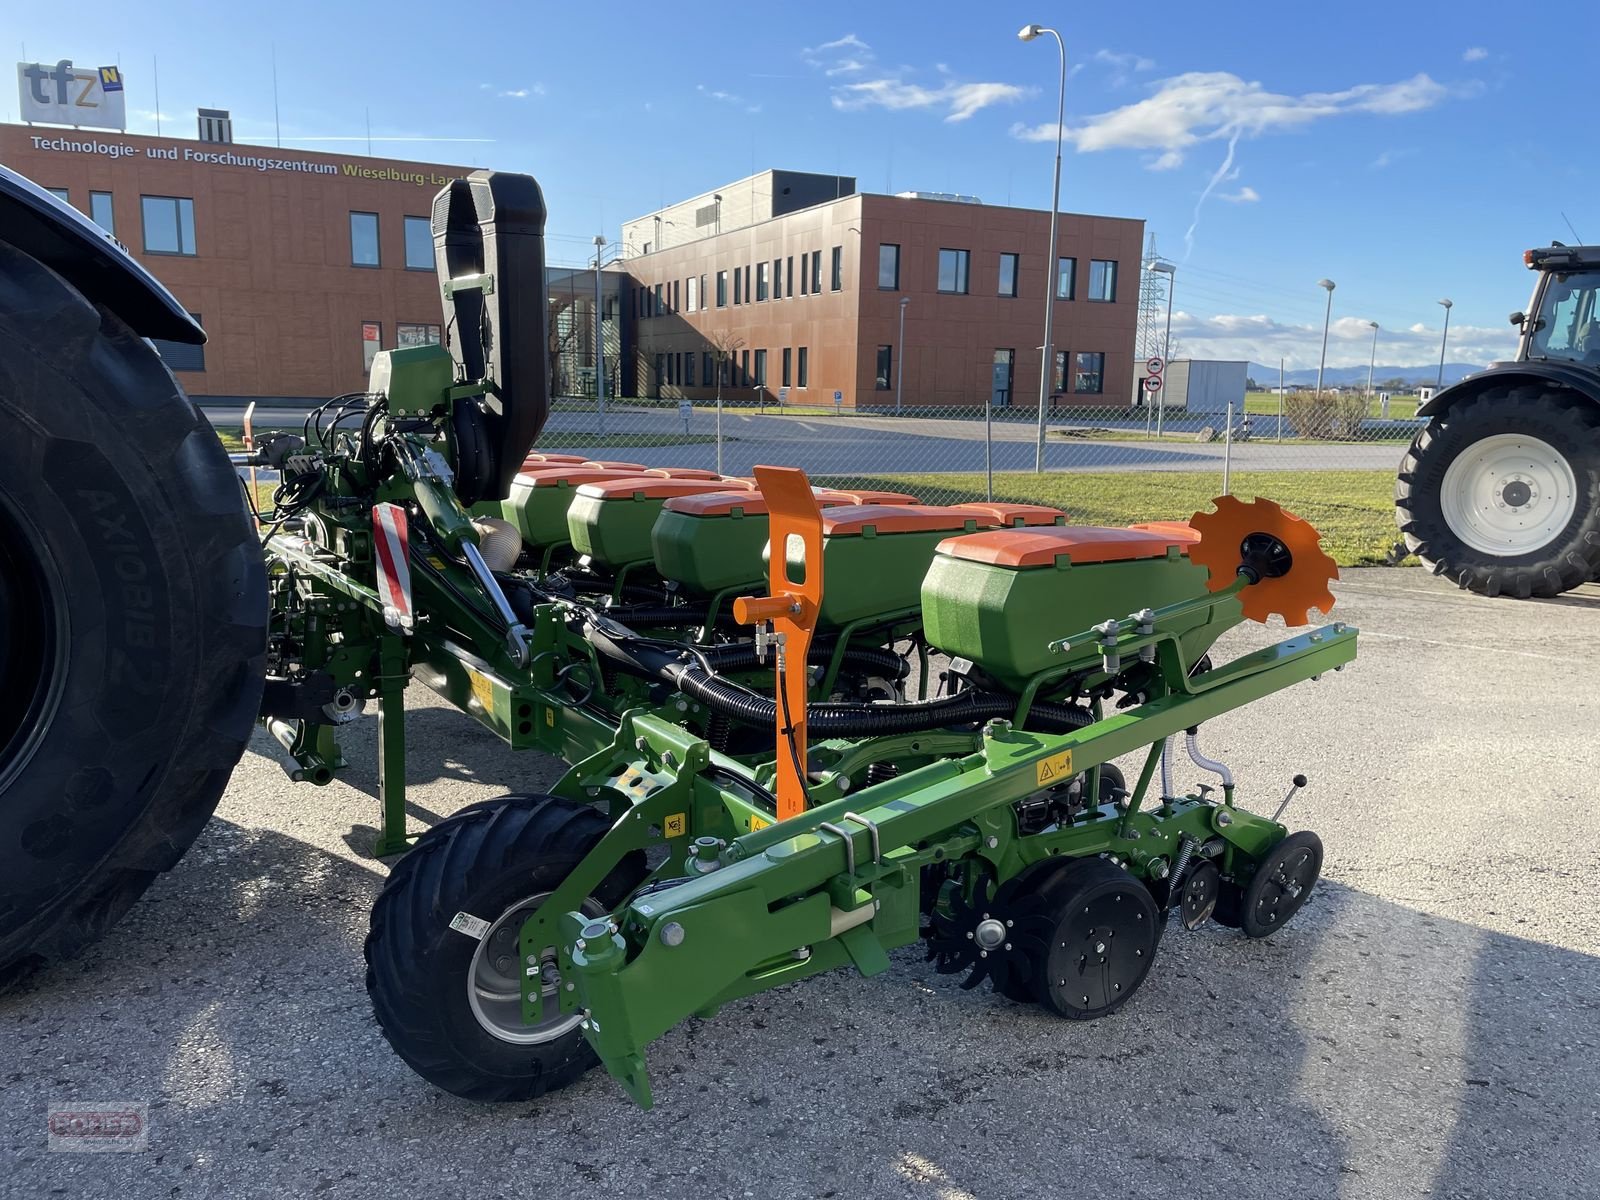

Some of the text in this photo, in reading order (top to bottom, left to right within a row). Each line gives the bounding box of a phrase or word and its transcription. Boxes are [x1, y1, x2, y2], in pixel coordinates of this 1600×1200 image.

[24, 59, 98, 108] tfz
[101, 67, 119, 84] N
[31, 136, 140, 159] Technologie-
[147, 147, 178, 160] und
[184, 148, 338, 175] Forschungszentrum
[76, 488, 157, 649] AXIOBIB
